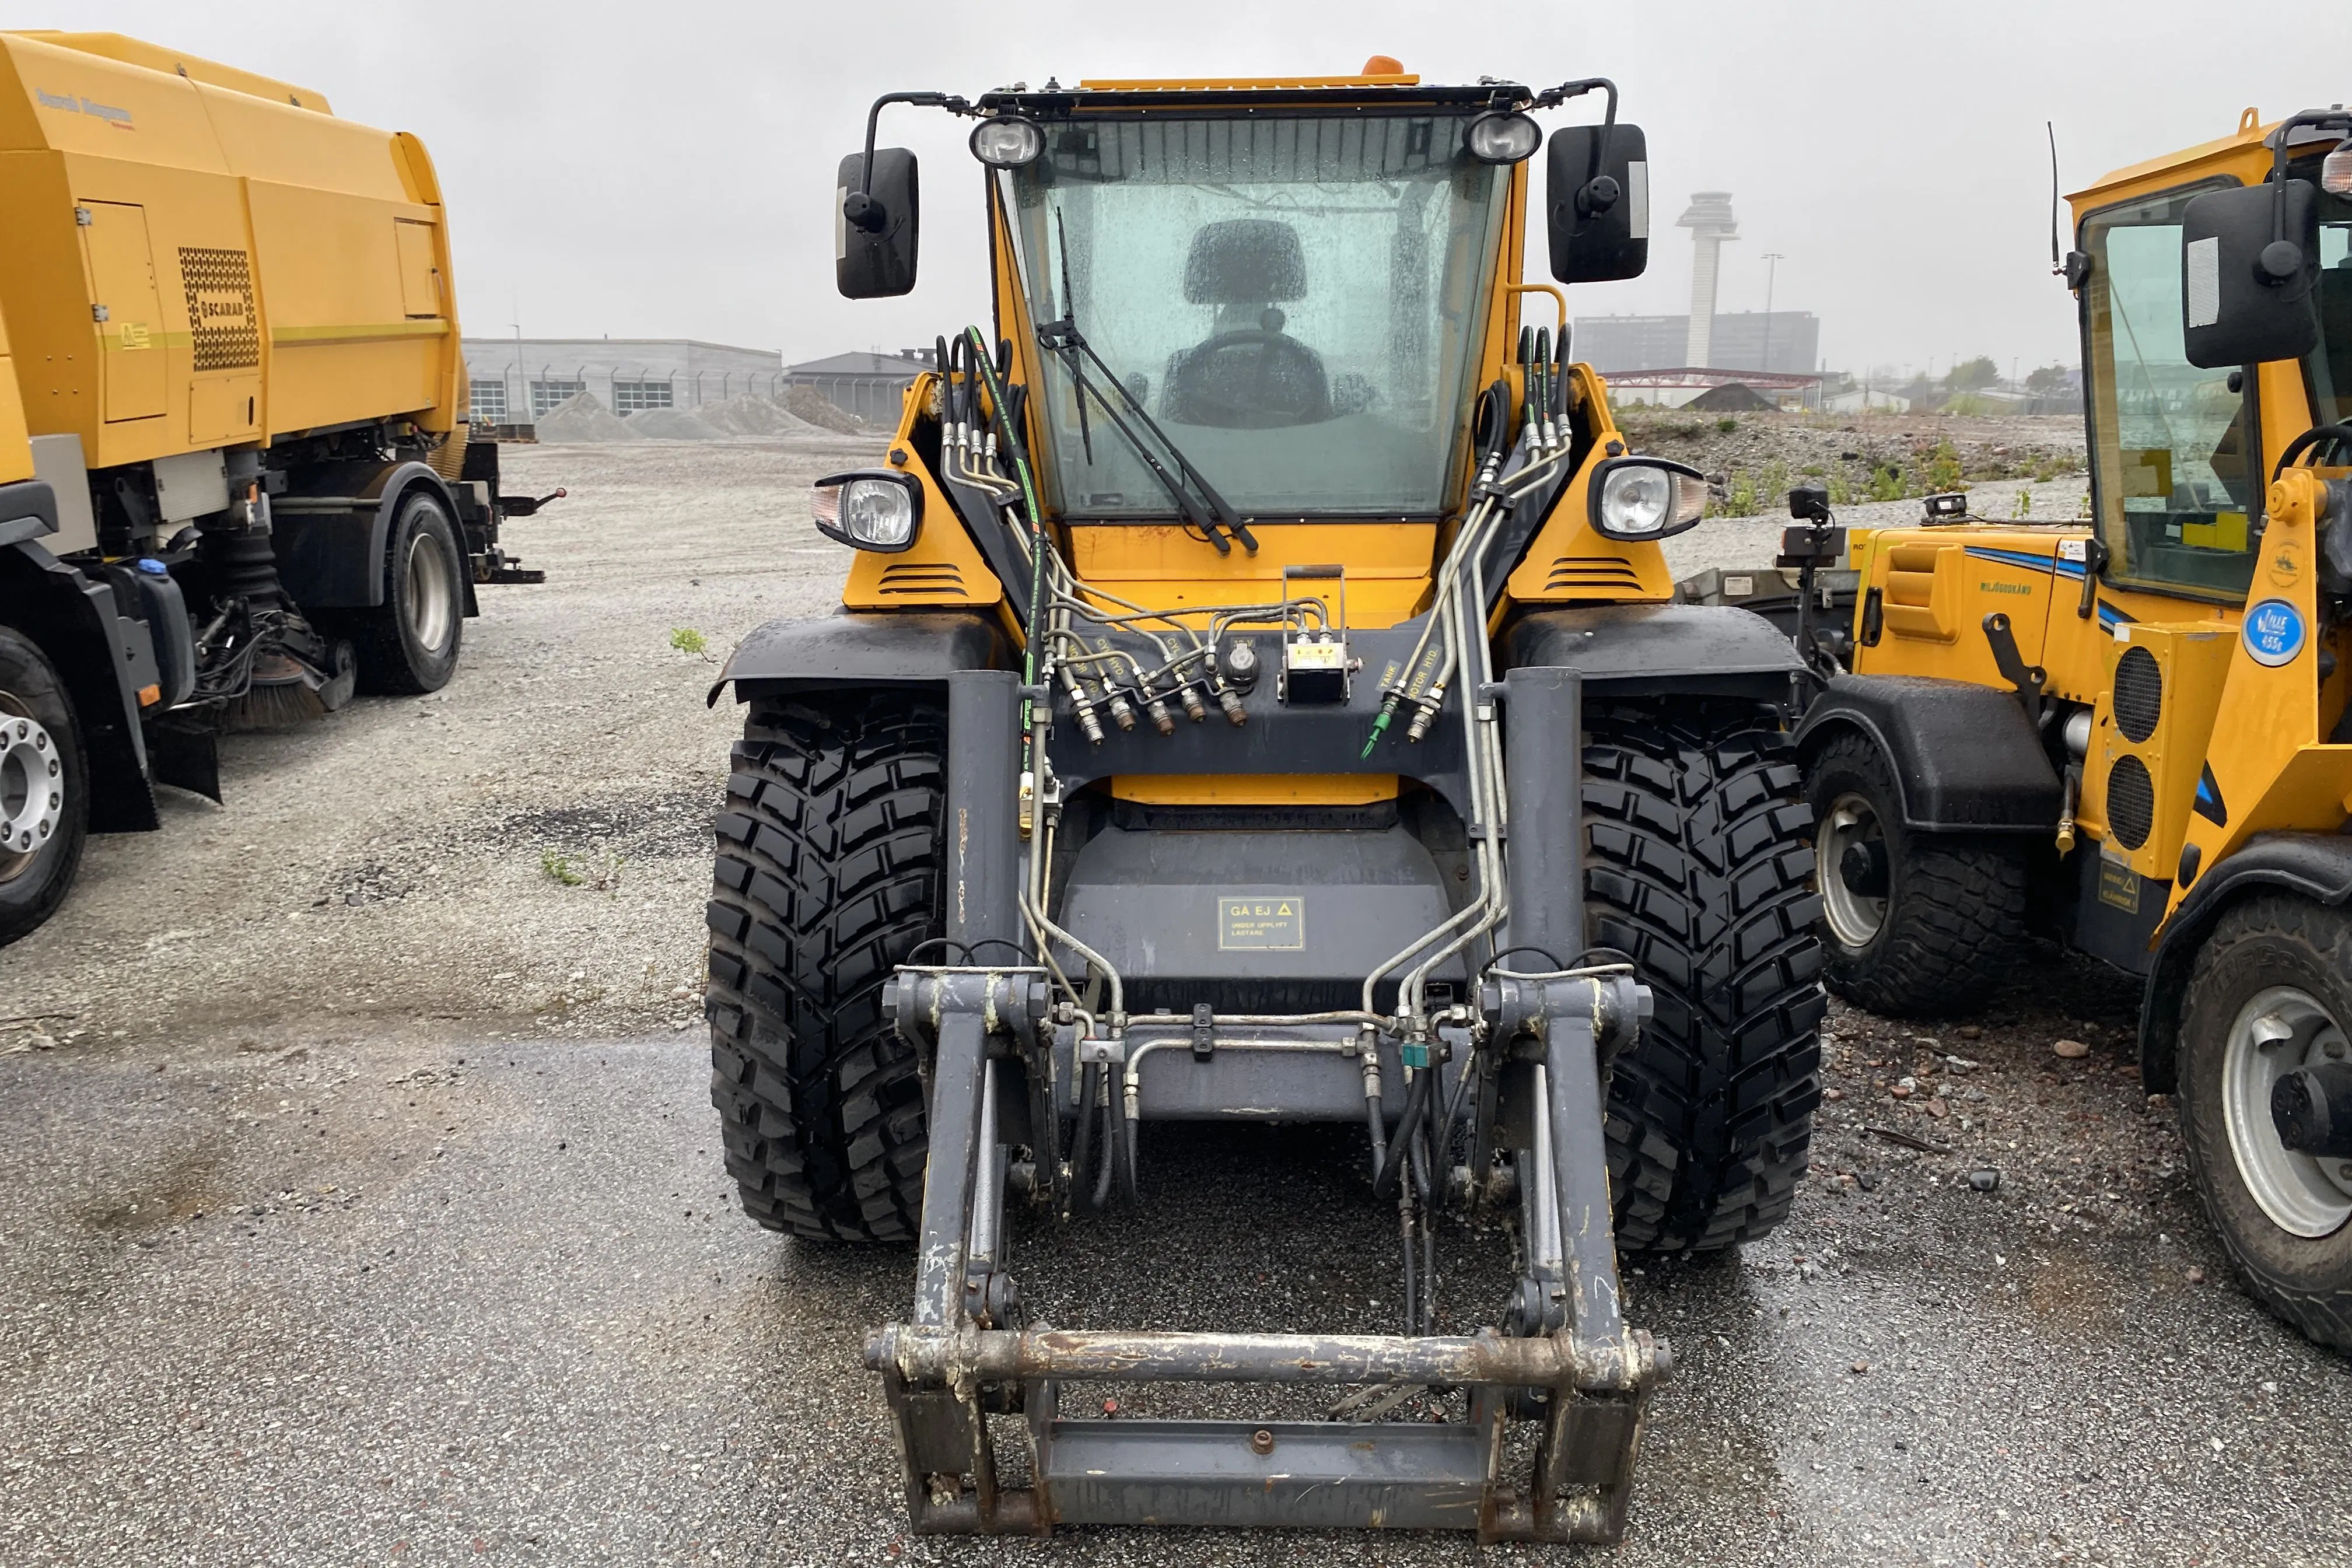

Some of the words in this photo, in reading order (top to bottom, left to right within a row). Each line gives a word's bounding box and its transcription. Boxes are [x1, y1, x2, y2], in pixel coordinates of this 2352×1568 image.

[208, 302, 244, 317] SCARAB
[1068, 645, 1087, 673] MOOR
[1423, 649, 1438, 668] HYD.
[1380, 665, 1396, 688] TANK
[1255, 906, 1270, 916] EJ
